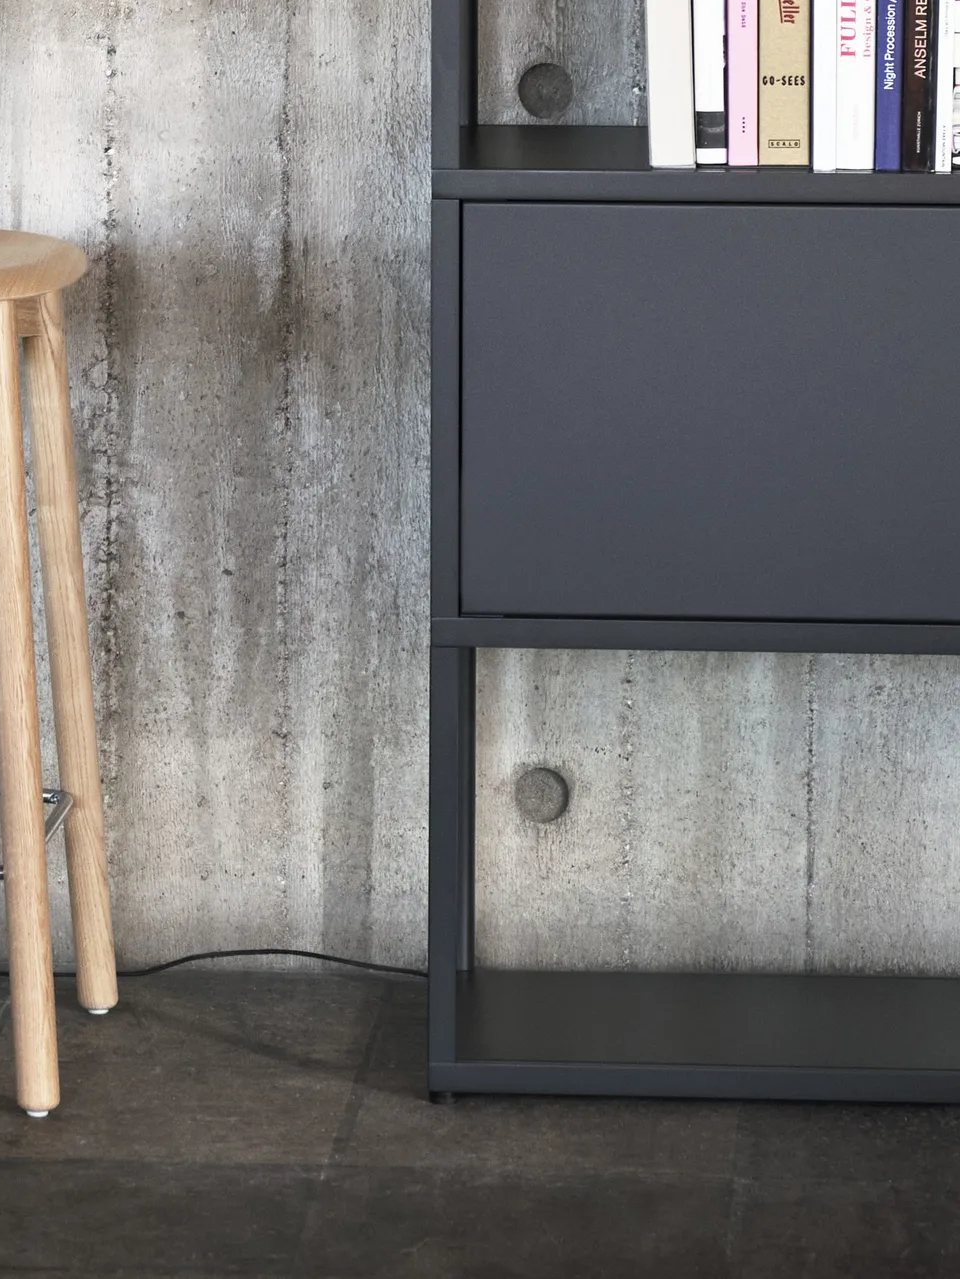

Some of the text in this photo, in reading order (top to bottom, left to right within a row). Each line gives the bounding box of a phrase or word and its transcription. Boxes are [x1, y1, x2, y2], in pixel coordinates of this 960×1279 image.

[863, 6, 872, 14] &
[863, 17, 874, 58] Design
[884, 4, 896, 61] Procession
[914, 19, 928, 79] ANSELM
[762, 75, 806, 86] GO-SEES
[883, 62, 897, 90] Night
